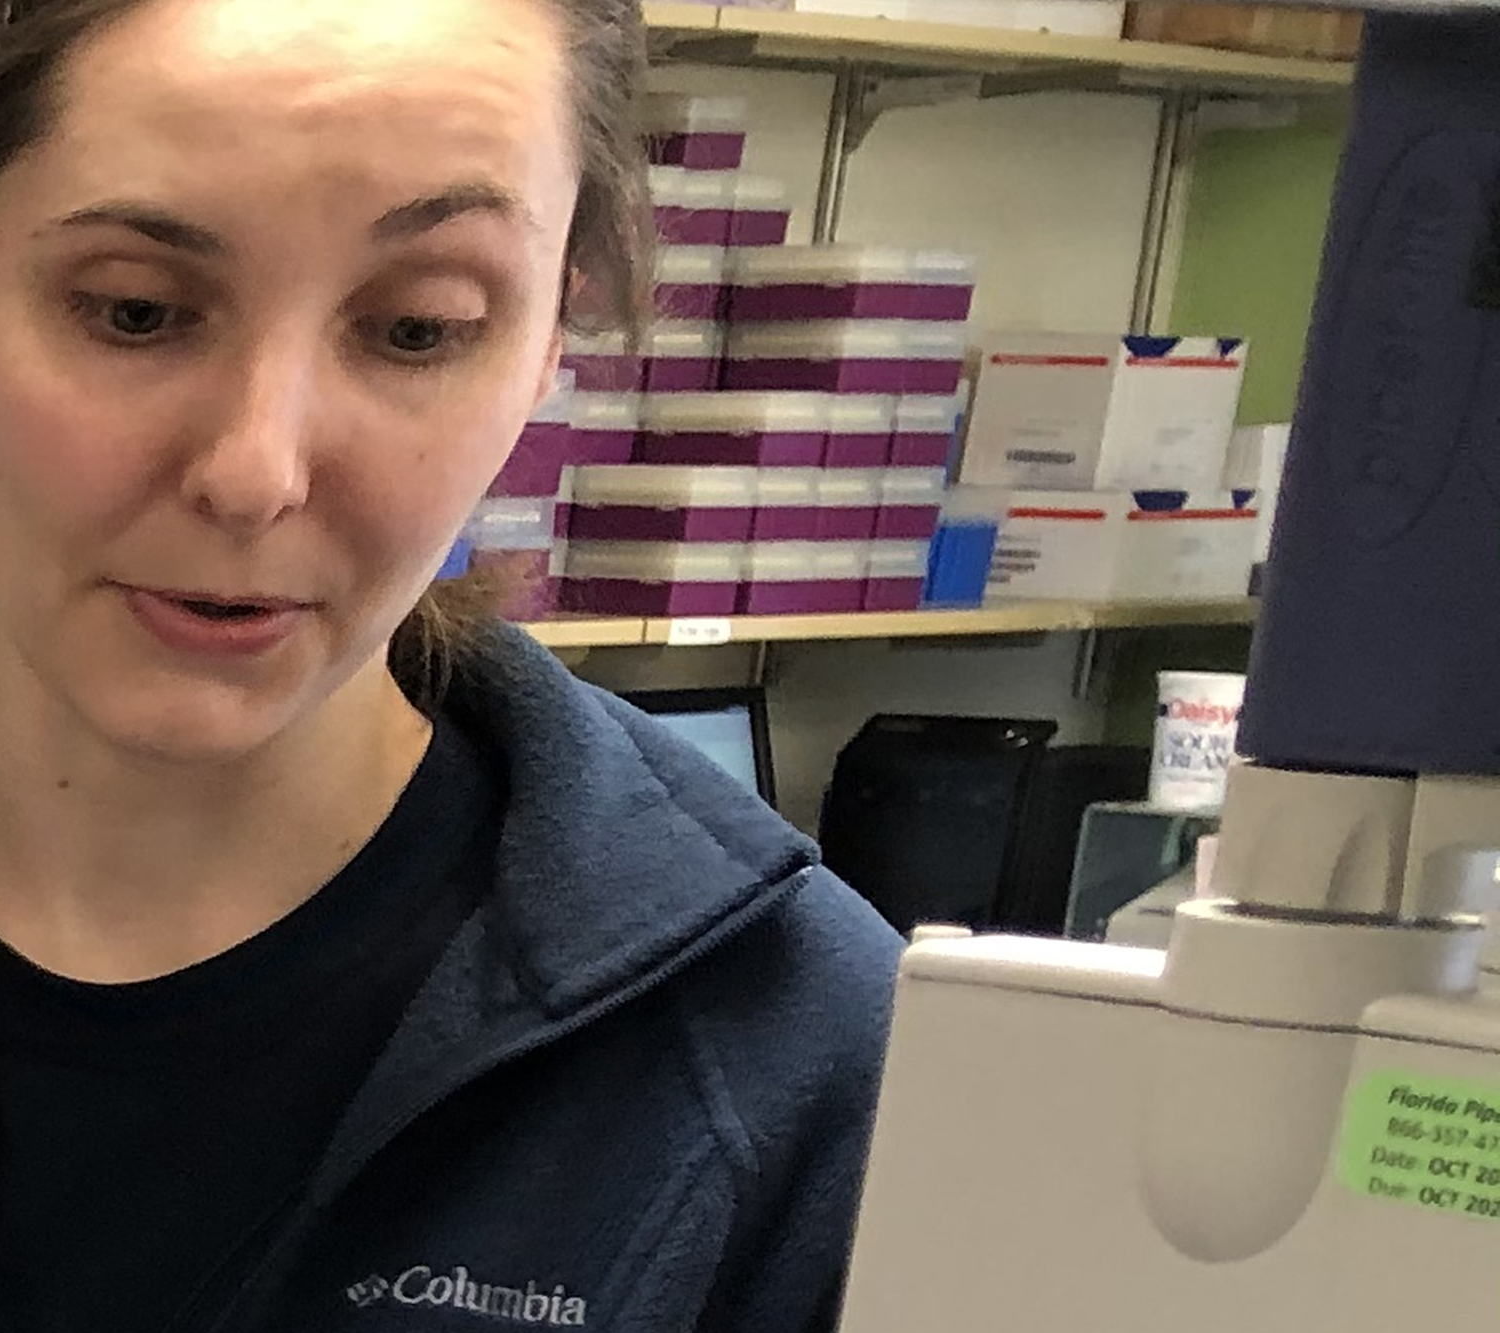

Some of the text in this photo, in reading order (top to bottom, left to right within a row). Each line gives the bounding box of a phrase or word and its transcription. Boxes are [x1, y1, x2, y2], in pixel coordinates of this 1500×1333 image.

[1167, 698, 1237, 727] Daisy
[1428, 1157, 1470, 1179] OCT
[1418, 1186, 1459, 1207] OCT
[392, 1264, 587, 1326] Columbia
